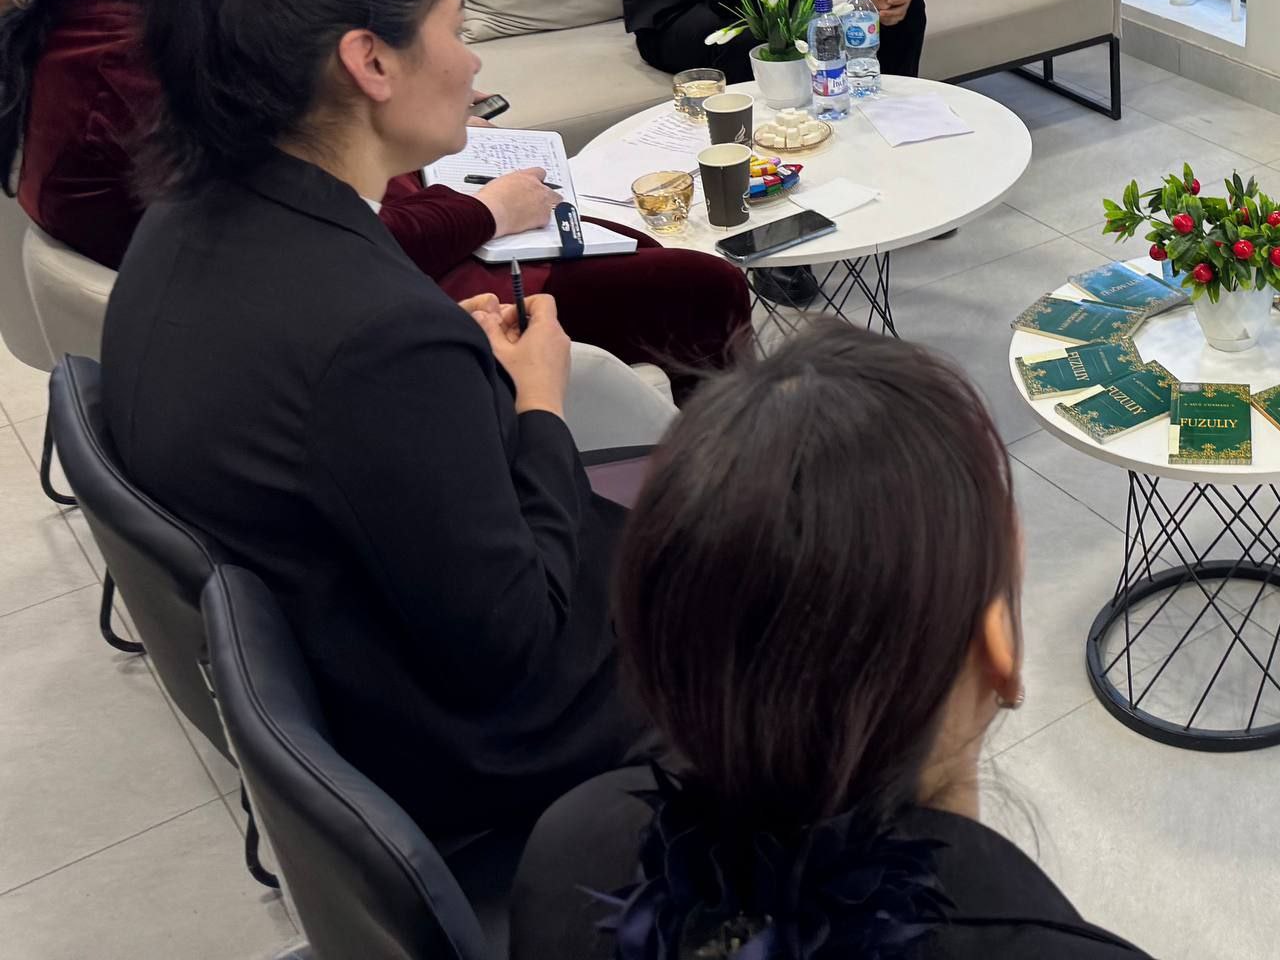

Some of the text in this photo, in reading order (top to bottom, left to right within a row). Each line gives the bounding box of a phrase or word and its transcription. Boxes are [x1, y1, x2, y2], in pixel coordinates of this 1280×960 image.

[1067, 351, 1090, 381] FUZULIY
[1107, 385, 1146, 415] FUZULIY
[1180, 418, 1238, 429] FUZULIY
